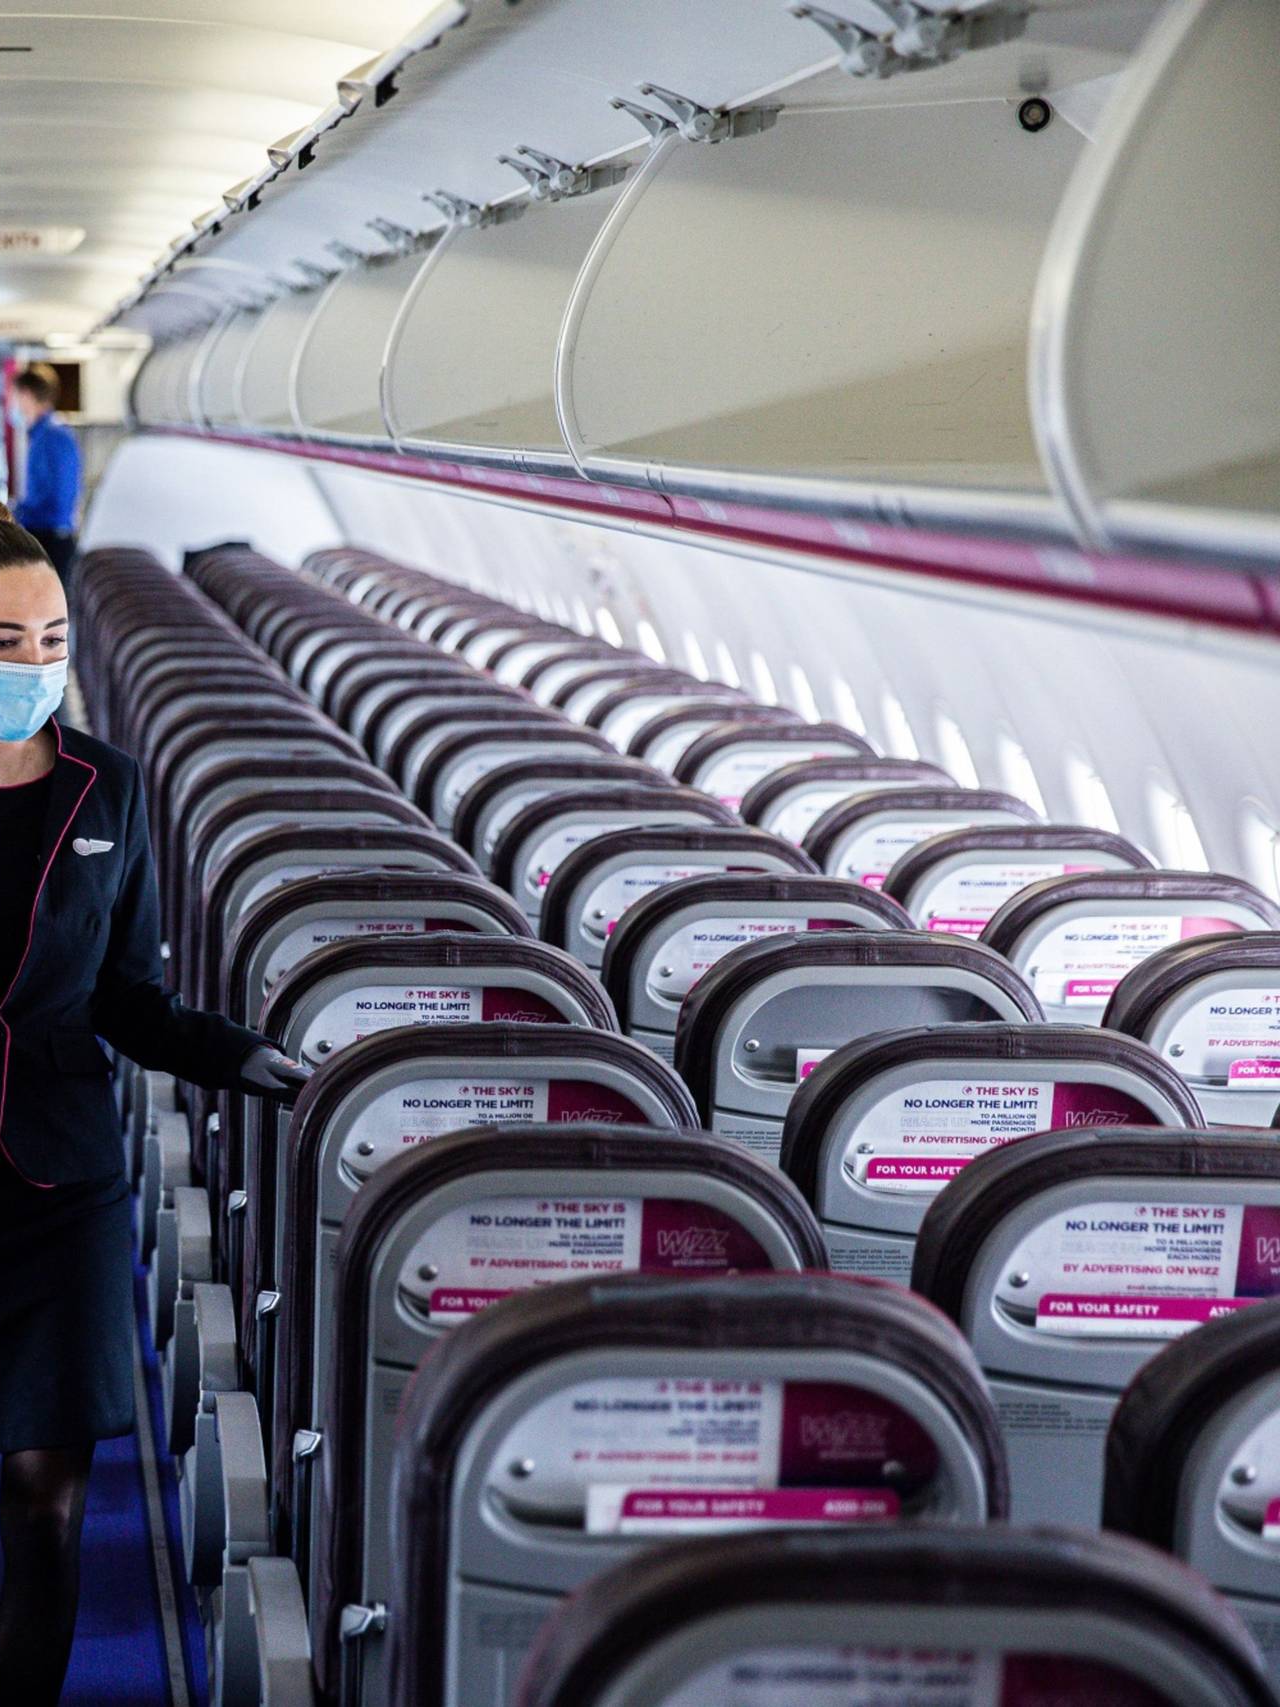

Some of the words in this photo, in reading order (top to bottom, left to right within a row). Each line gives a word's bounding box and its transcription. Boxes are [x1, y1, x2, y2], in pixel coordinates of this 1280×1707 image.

[366, 923, 384, 931] THE
[387, 923, 404, 931] SKY
[408, 923, 414, 931] IS
[417, 991, 437, 999] THE
[439, 991, 459, 999] SKY
[461, 991, 470, 999] IS
[356, 1002, 372, 1011] NO
[374, 1002, 416, 1011] LONGER
[419, 1002, 438, 1011] THE
[440, 1002, 470, 1011] LIMIT!
[1210, 1007, 1226, 1015] NO
[1229, 1007, 1272, 1015] LONGER
[473, 1087, 494, 1096] THE
[497, 1087, 520, 1096] SKY
[524, 1087, 534, 1096] IS
[976, 1087, 999, 1096] THE
[1002, 1087, 1025, 1096] SKY
[1028, 1087, 1039, 1096] IS
[403, 1099, 420, 1109] NO
[424, 1099, 471, 1109] LONGER
[474, 1099, 496, 1109] THE
[500, 1099, 534, 1109] LIMIT!
[904, 1099, 922, 1109] NO
[926, 1099, 974, 1109] LONGER
[979, 1099, 1000, 1109] THE
[1003, 1099, 1038, 1109] LIMIT!
[903, 1136, 916, 1144] BY
[919, 1136, 987, 1144] ADVERTISING
[989, 1136, 1005, 1144] ON
[876, 1166, 896, 1175] FOR
[899, 1166, 927, 1175] YOUR
[931, 1166, 962, 1175] SAFET
[554, 1203, 579, 1213] THE
[583, 1203, 609, 1213] SKY
[613, 1203, 625, 1213] IS
[1152, 1209, 1179, 1218] THE
[1183, 1209, 1209, 1218] SKY
[1213, 1209, 1226, 1218] IS
[470, 1216, 491, 1228] NO
[495, 1216, 551, 1228] LONGER
[555, 1216, 581, 1228] THE
[585, 1216, 625, 1228] LIMIT!
[1066, 1221, 1087, 1231] NO
[1091, 1222, 1149, 1232] LONGER
[1154, 1223, 1179, 1233] THE
[1184, 1224, 1224, 1234] LIMIT!
[470, 1258, 485, 1268] BY
[490, 1258, 568, 1270] ADVERTISING
[572, 1258, 589, 1270] ON
[1064, 1264, 1079, 1273] BY
[1083, 1265, 1163, 1274] ADVERTISING
[1166, 1266, 1184, 1275] ON
[1188, 1267, 1219, 1276] WIZZ
[440, 1298, 464, 1308] FOR
[1050, 1303, 1073, 1313] FOR
[1078, 1304, 1110, 1314] YOUR
[1114, 1305, 1160, 1315] SAFETY
